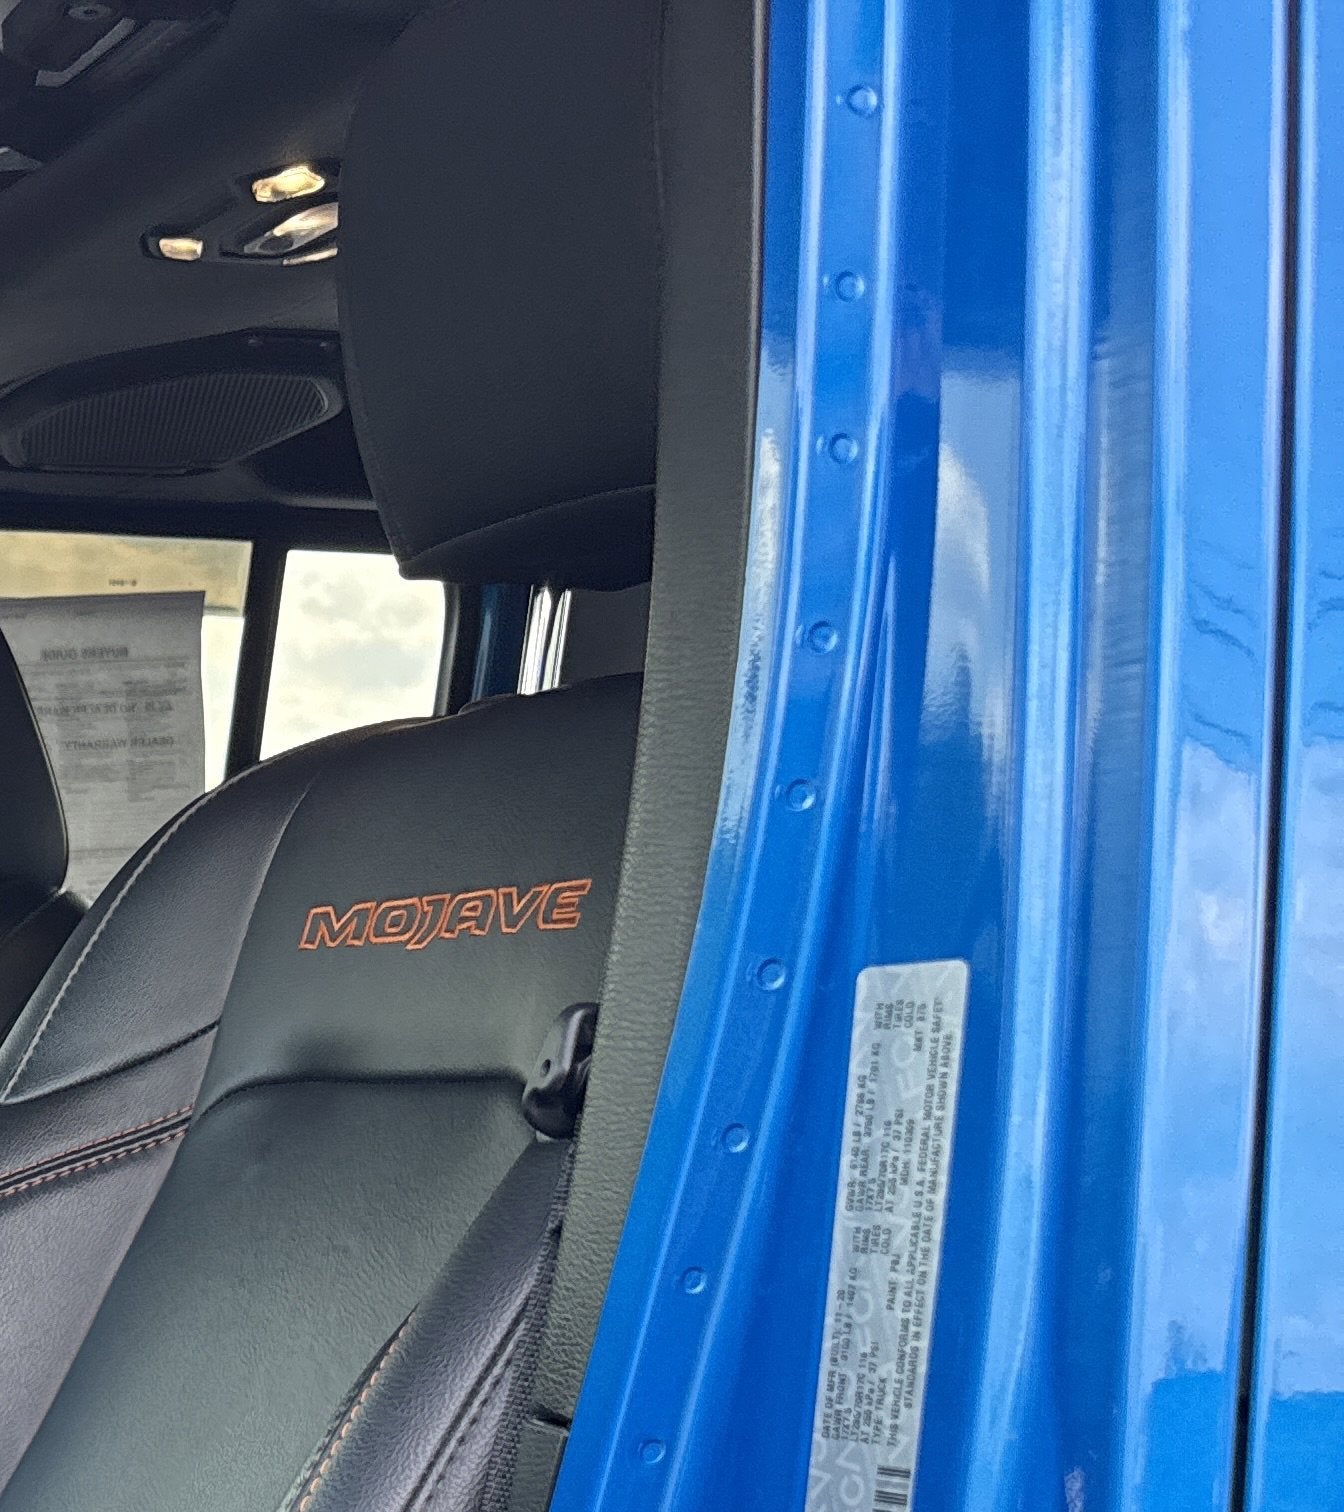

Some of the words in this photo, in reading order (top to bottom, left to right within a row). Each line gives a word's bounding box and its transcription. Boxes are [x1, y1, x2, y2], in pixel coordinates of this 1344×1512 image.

[298, 878, 593, 951] MOJAVE
[927, 1036, 939, 1079] VEHICLE
[923, 1083, 934, 1119] MOTOR
[936, 1072, 948, 1110] SHOWN
[917, 1124, 929, 1171] FEDERAL
[927, 1114, 943, 1193] MANUFACTURE
[925, 1197, 934, 1209] OF
[870, 1224, 880, 1254] TIRES
[906, 1211, 920, 1274] APPLICABLE
[922, 1215, 932, 1242] DATE
[919, 1246, 929, 1266] THE
[904, 1278, 913, 1297] ALL
[917, 1270, 926, 1285] ON
[902, 1301, 910, 1313] TO
[913, 1289, 924, 1326] EFFECT
[895, 1317, 909, 1374] CONFORMS
[911, 1330, 920, 1341] IN
[876, 1376, 886, 1410] TRUCK
[904, 1345, 918, 1408] STANDARDS
[891, 1378, 902, 1418] VEHICLE
[822, 1412, 832, 1438] DATE
[888, 1423, 897, 1446] THIS
